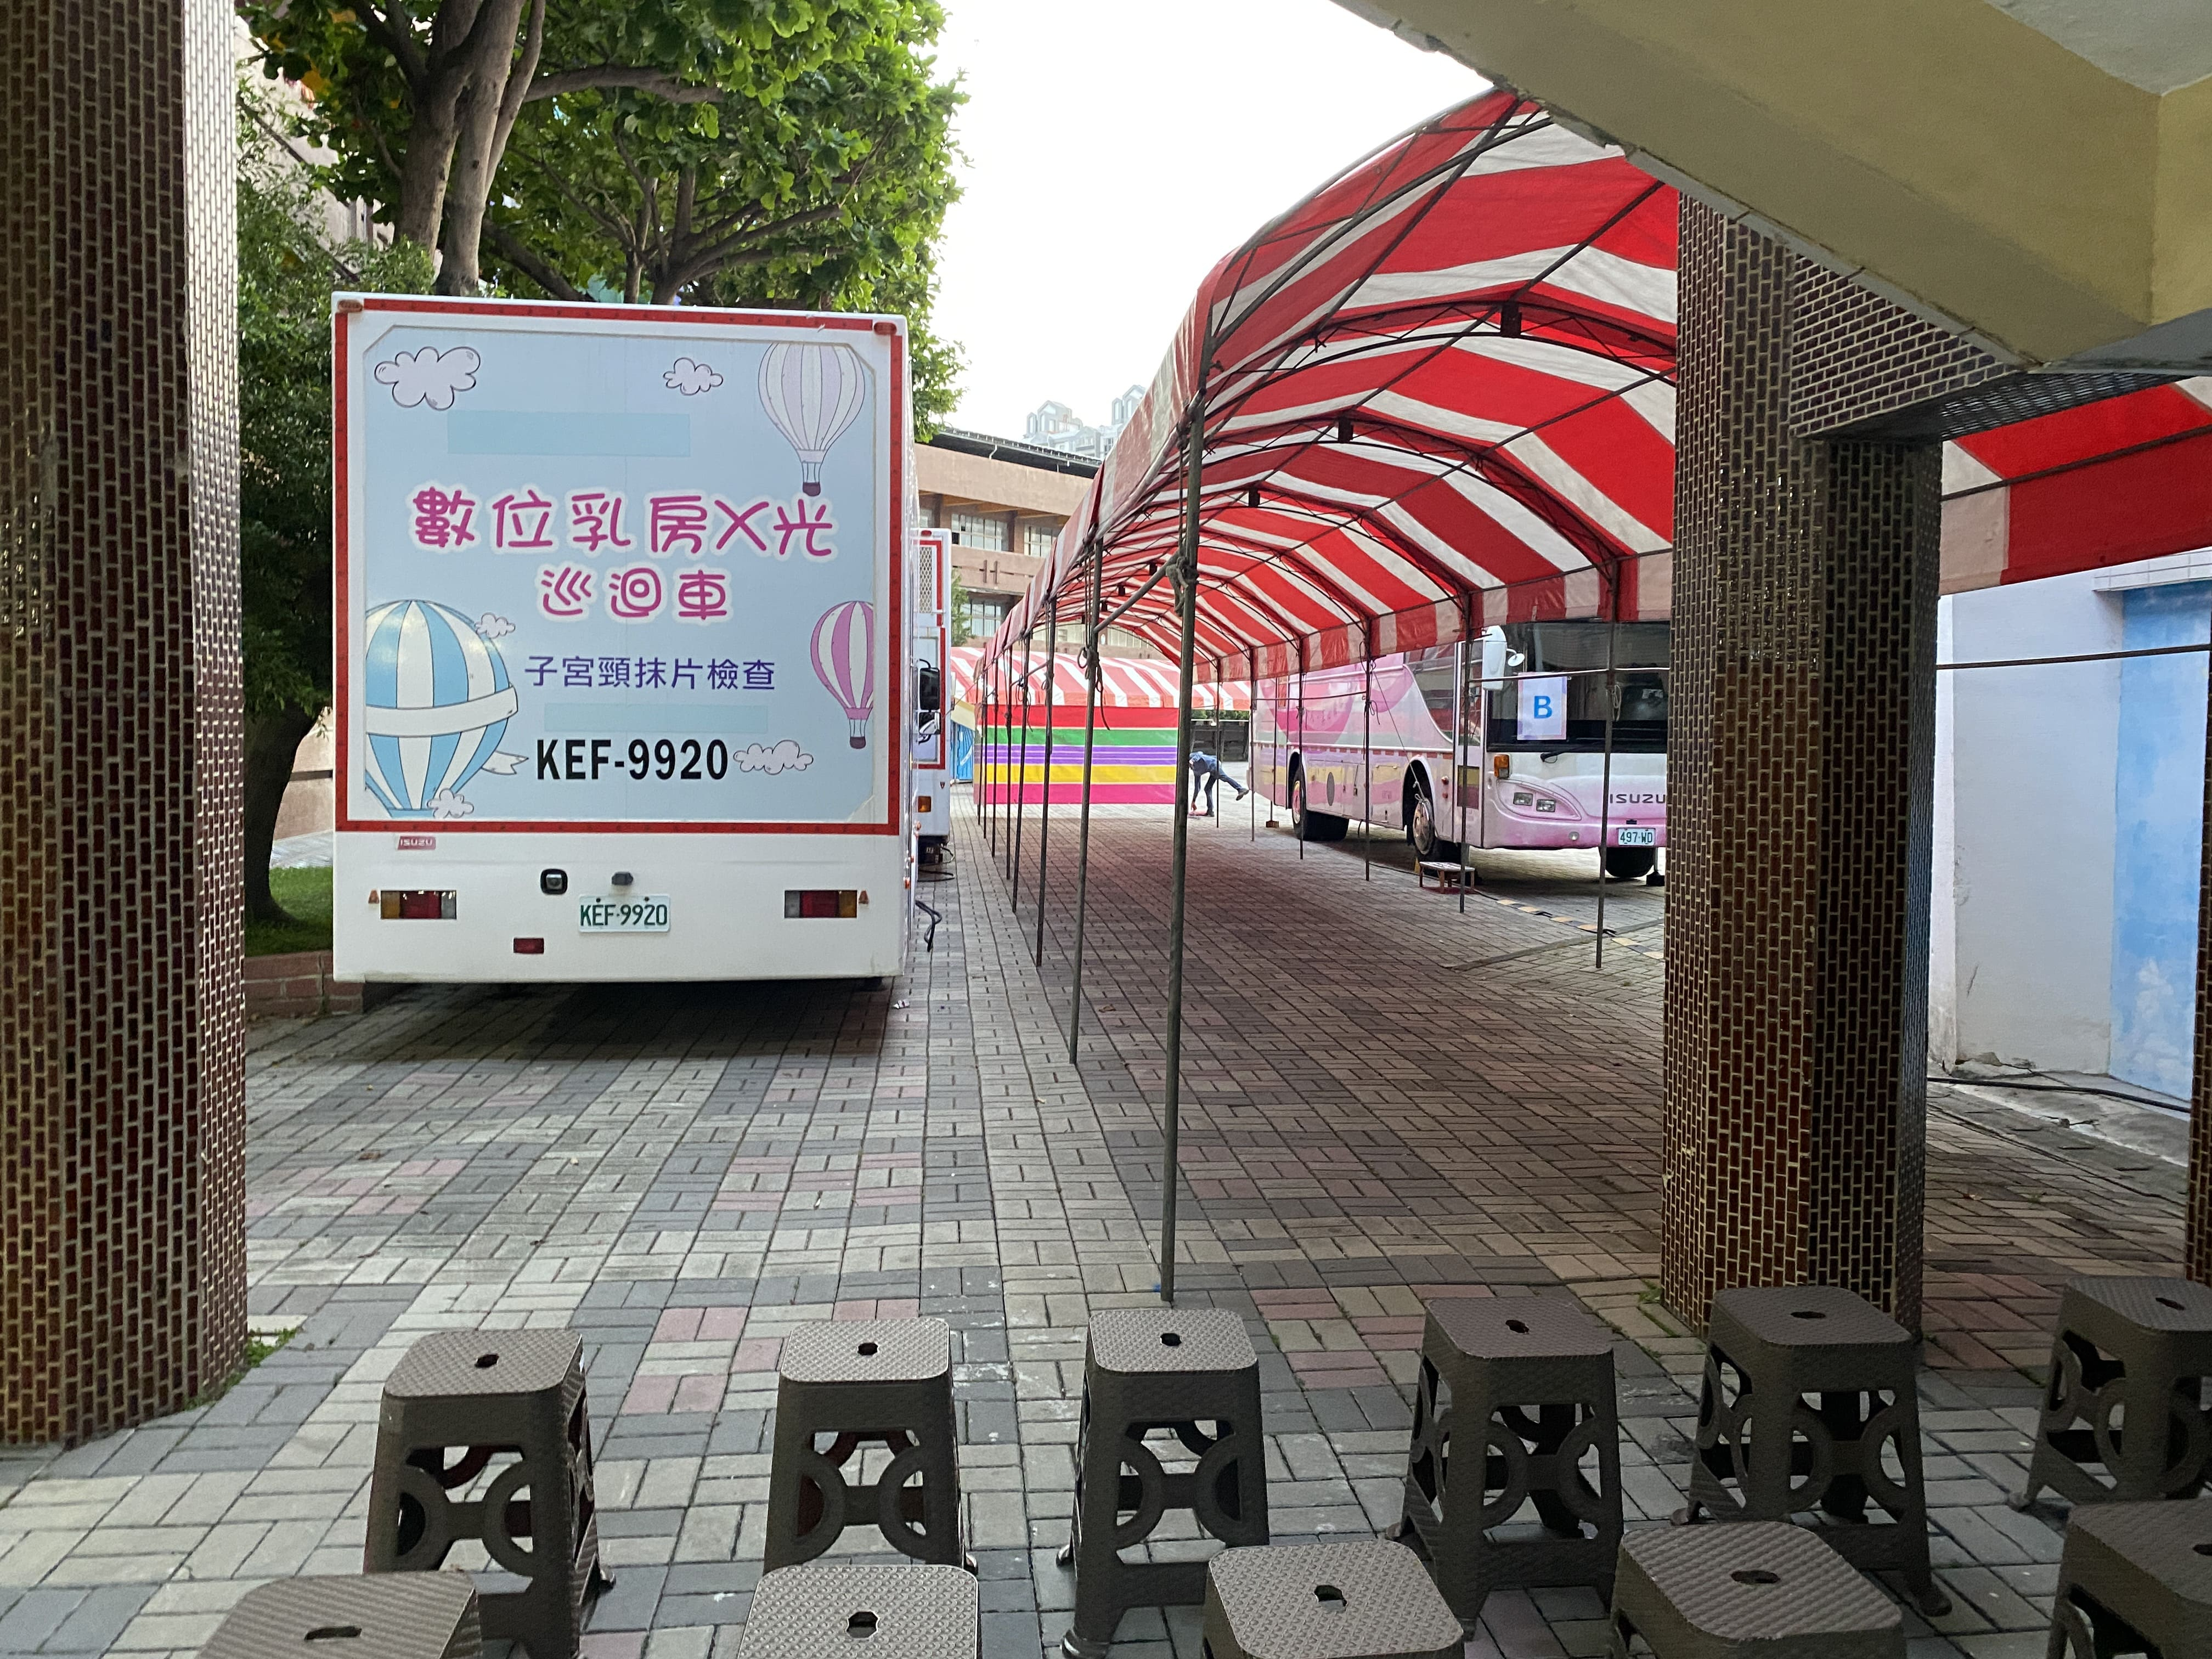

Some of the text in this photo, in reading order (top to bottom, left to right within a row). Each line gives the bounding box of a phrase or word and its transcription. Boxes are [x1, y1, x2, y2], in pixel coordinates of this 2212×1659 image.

[412, 487, 833, 556] 數位乳房X光
[541, 567, 727, 620] 巡迴車
[524, 656, 775, 690] 子宮頸抹片檢查
[1533, 695, 1553, 719] B
[537, 739, 728, 780] KEF-9920
[1609, 793, 1666, 804] ISUZU
[399, 838, 433, 847] ISUZU
[1620, 832, 1653, 843] 497-WD
[580, 904, 668, 927] KEF-9920
